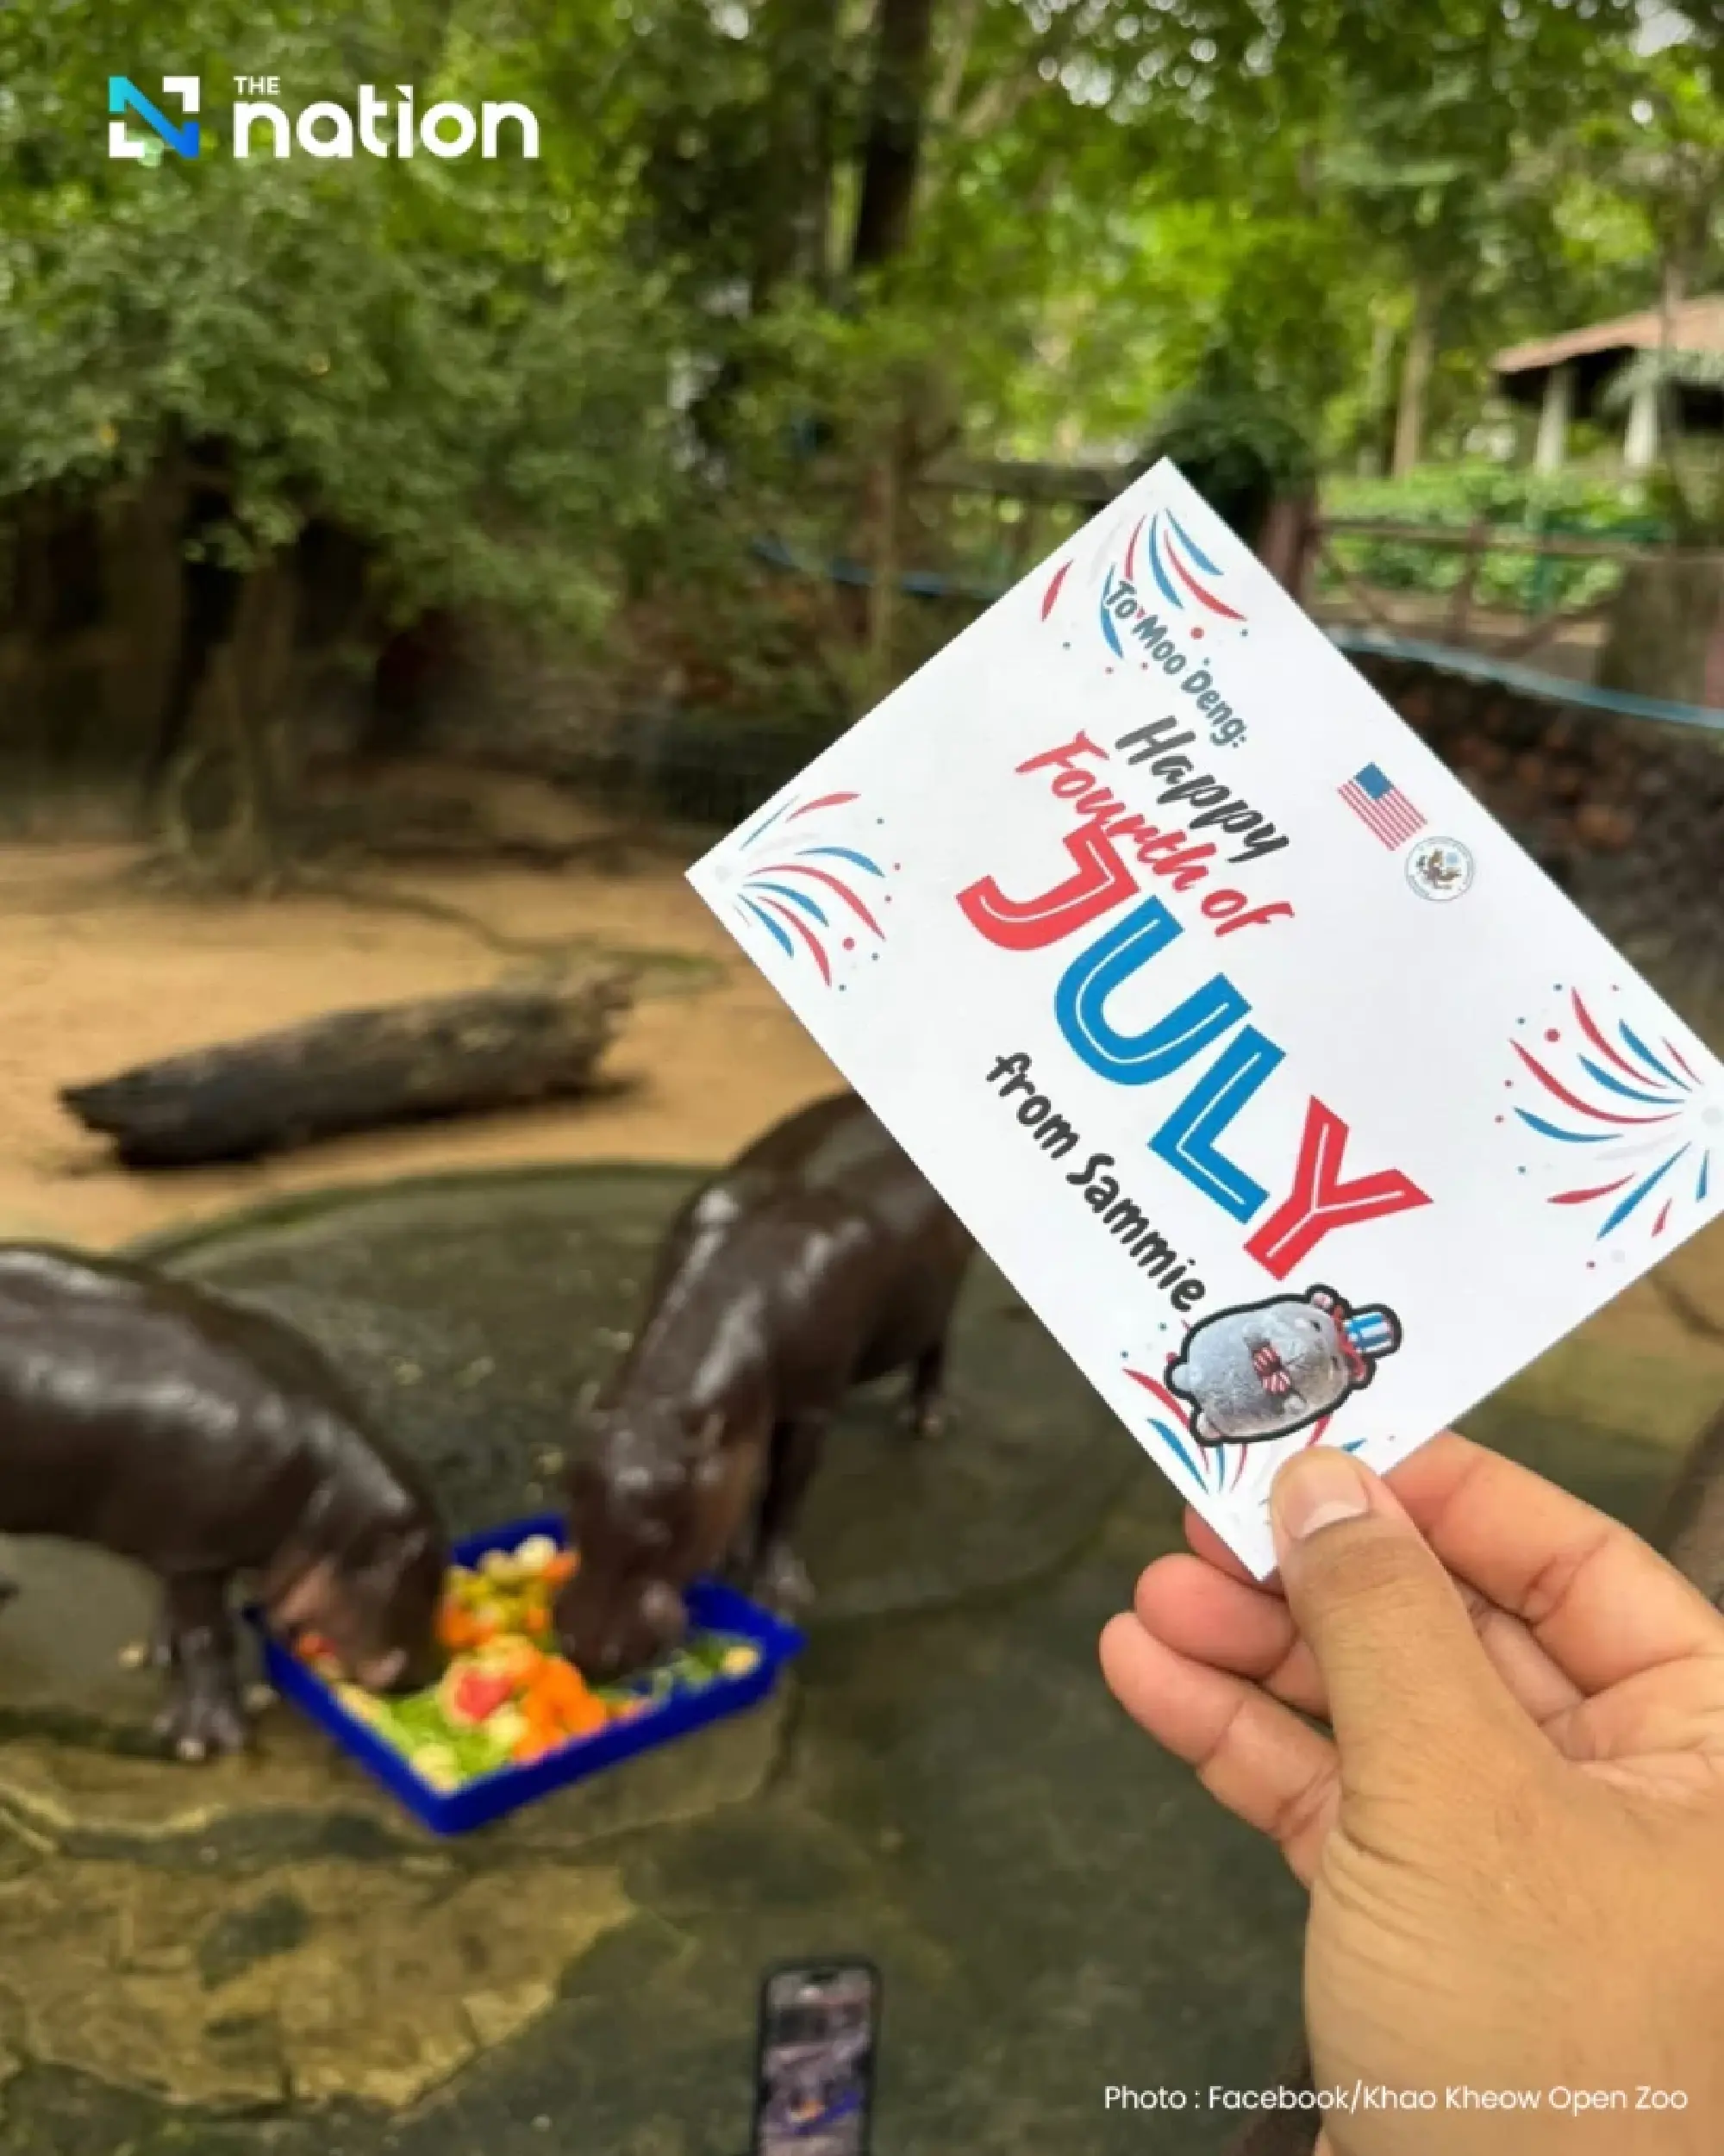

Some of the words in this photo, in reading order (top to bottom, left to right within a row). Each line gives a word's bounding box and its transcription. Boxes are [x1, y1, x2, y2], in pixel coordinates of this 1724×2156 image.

[1107, 580, 1139, 620] To
[1132, 613, 1188, 676] Moo
[1181, 667, 1247, 748] Deng:
[1015, 730, 1217, 891] Fourth
[1200, 888, 1295, 938] of
[1115, 715, 1290, 863] Happy
[955, 822, 1434, 1282] JULY
[986, 1052, 1080, 1159] from
[1065, 1153, 1207, 1313] Sammie
